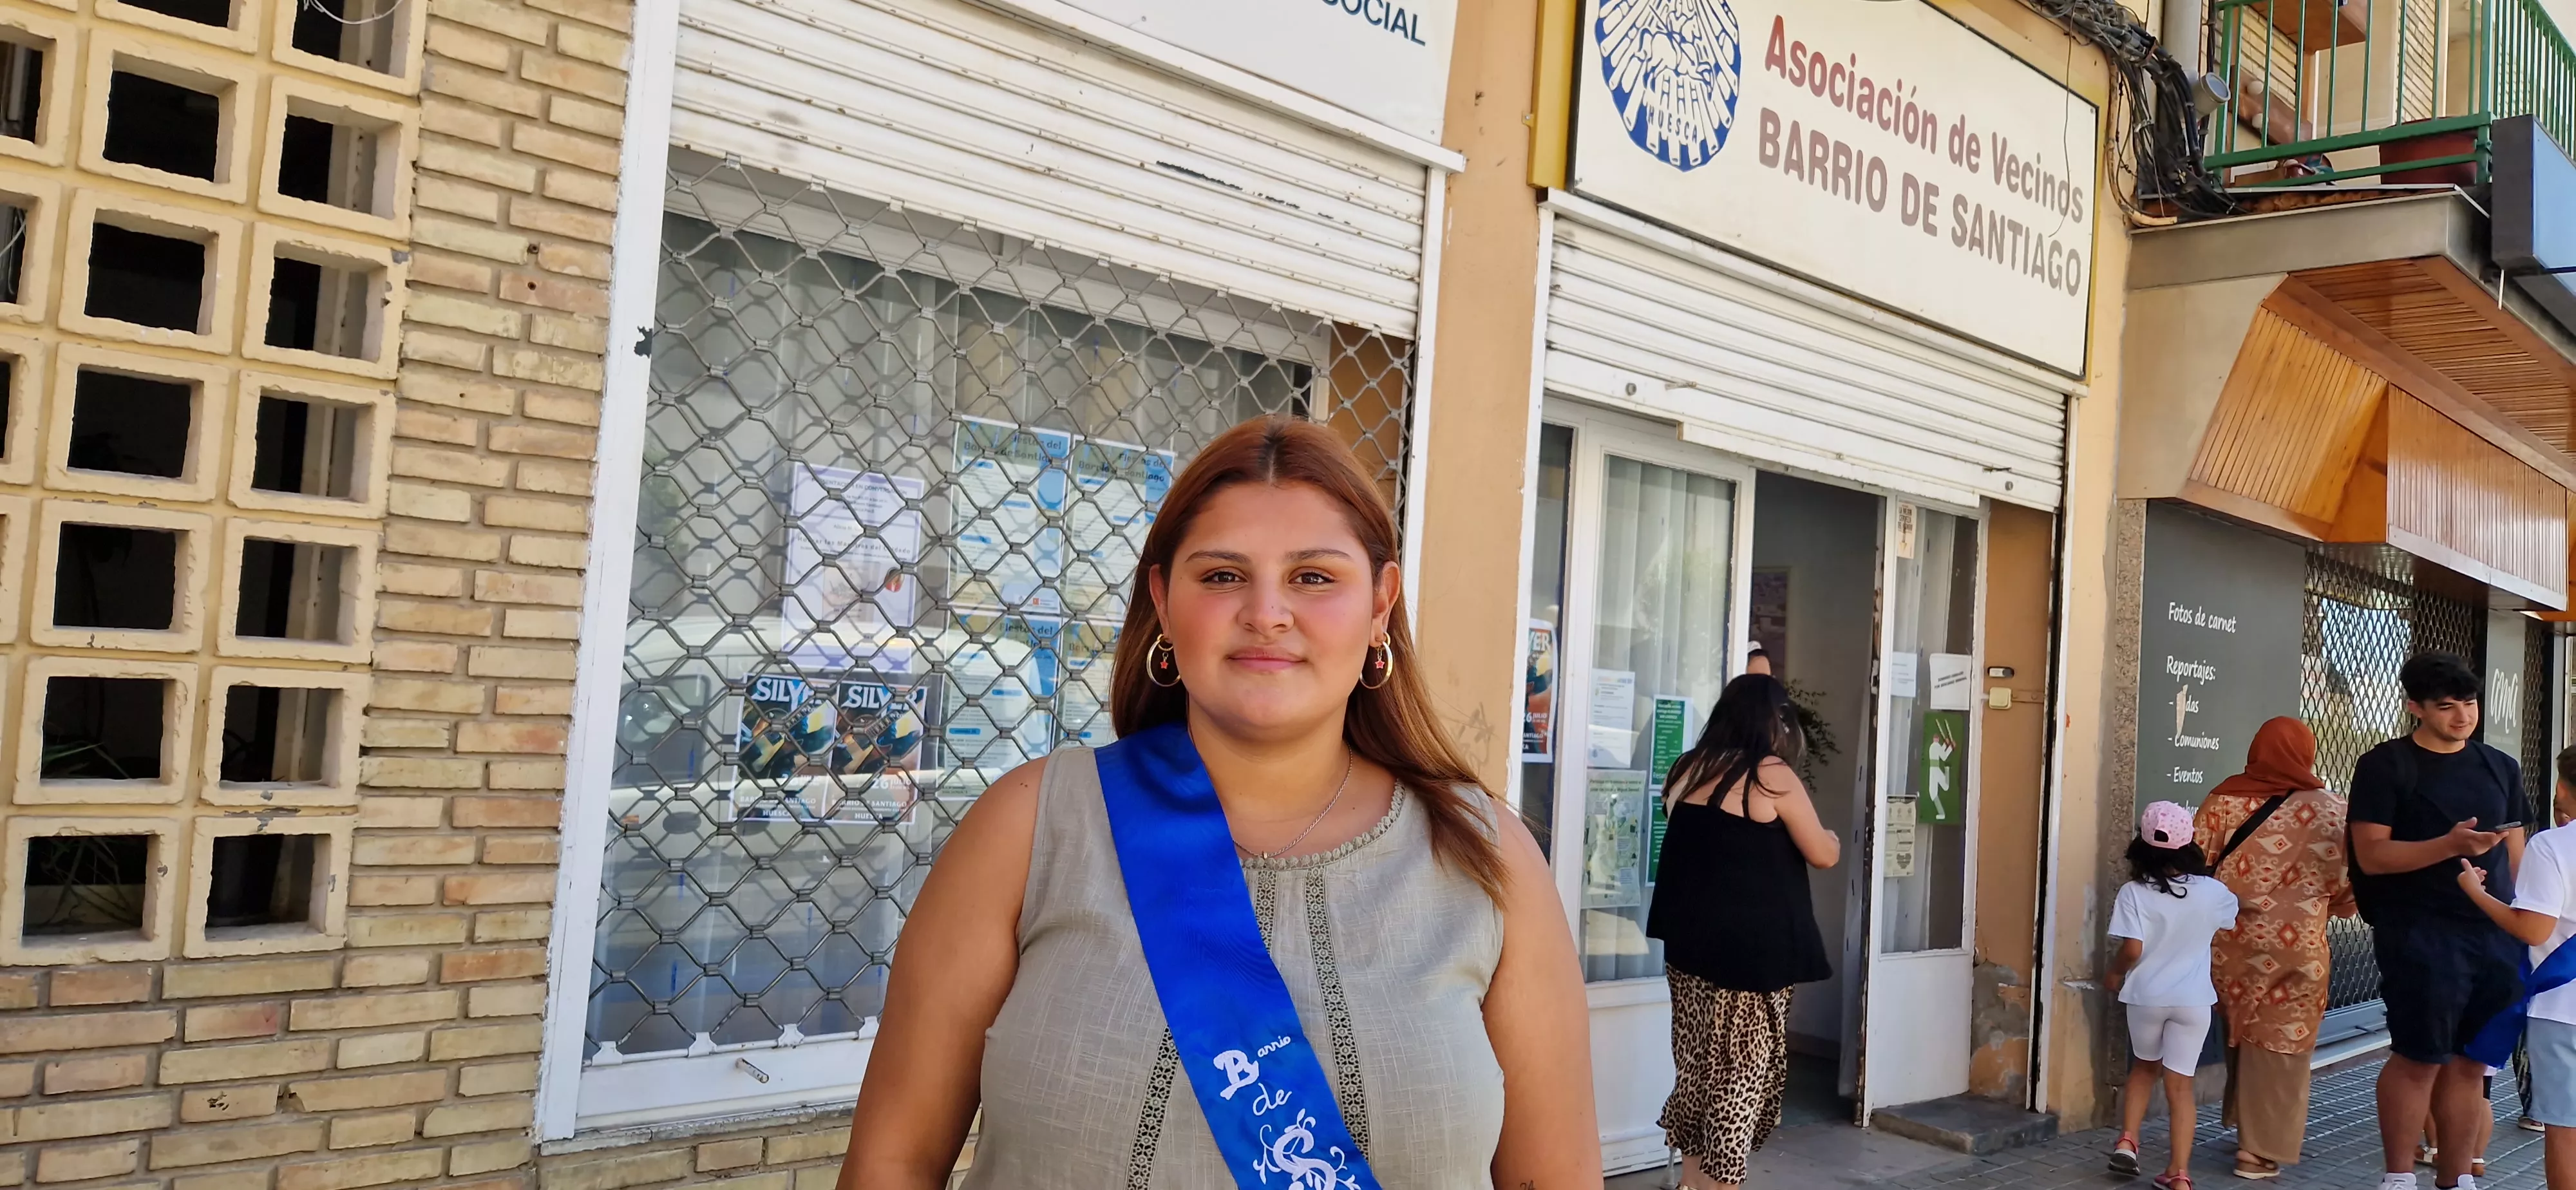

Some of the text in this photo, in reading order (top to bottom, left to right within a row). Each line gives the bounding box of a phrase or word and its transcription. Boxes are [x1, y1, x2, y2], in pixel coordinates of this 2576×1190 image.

[1322, 0, 1426, 46] OCIAL
[1648, 104, 1698, 144] HUESCA
[1765, 15, 2084, 223] Asociación de Vecinos
[1759, 107, 2082, 297] BARRIO DE SANTIAGO
[2168, 601, 2237, 634] Fotos de carnet
[2166, 655, 2216, 685] Reportajes:
[2174, 733, 2220, 751] Comuniones
[2174, 766, 2203, 784] Eventos
[1253, 1082, 1293, 1115] de
